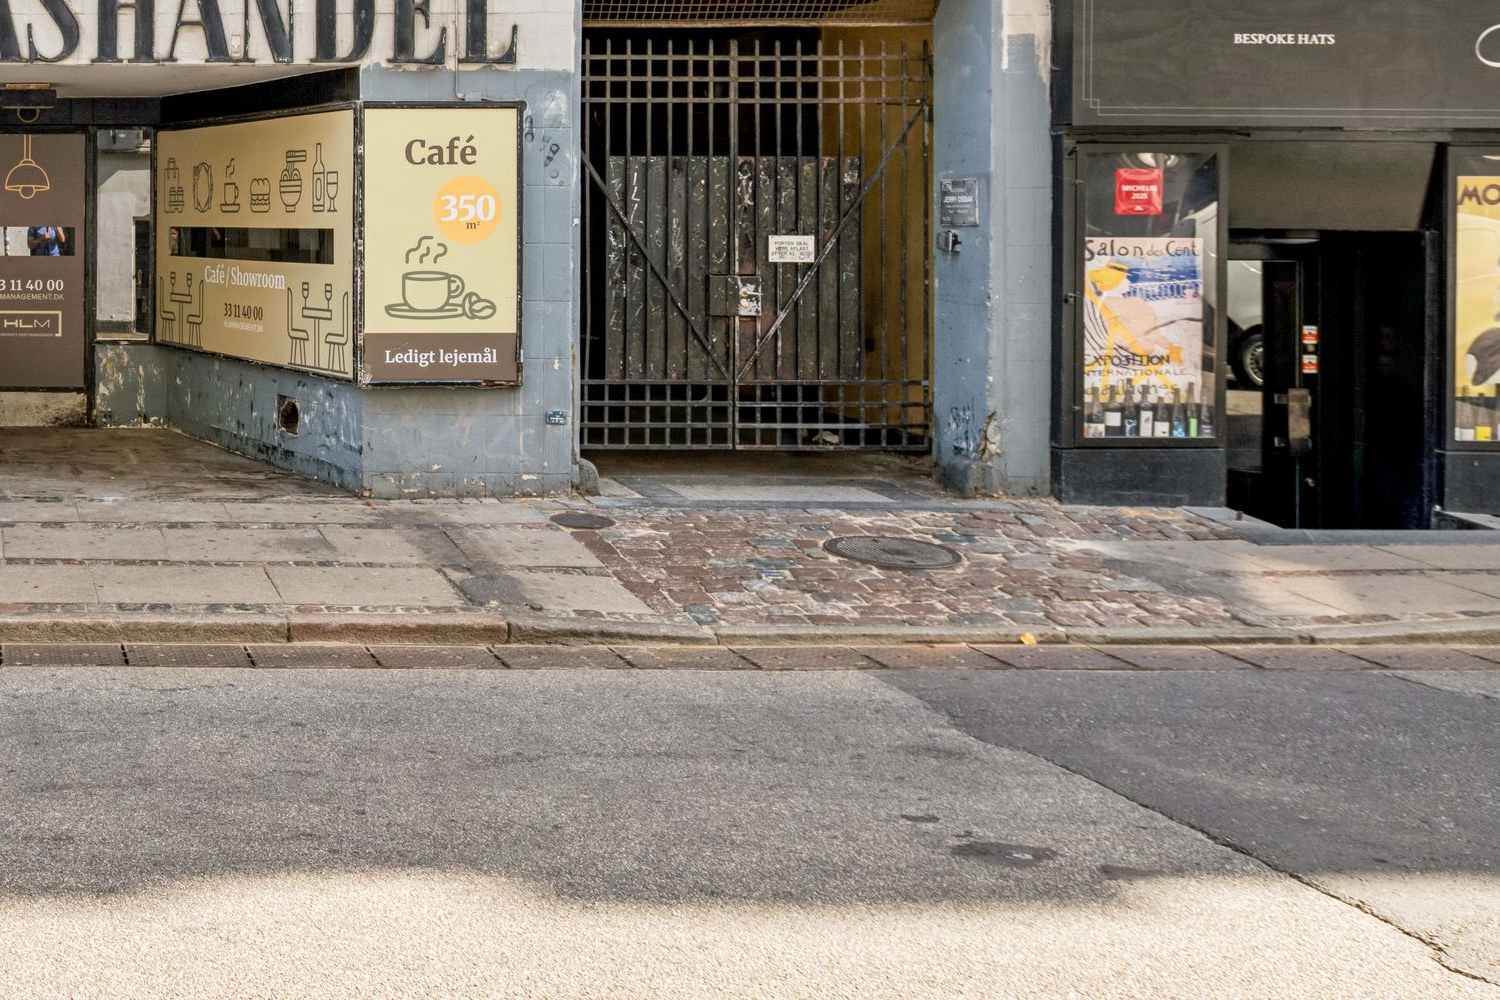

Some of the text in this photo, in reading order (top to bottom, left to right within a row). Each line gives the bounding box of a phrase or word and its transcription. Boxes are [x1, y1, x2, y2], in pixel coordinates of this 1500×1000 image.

[1233, 32, 1336, 46] BESPOKE HATS
[405, 135, 477, 166] Café
[1121, 184, 1158, 192] MICHELIN
[1457, 183, 1500, 206] MO
[440, 194, 496, 222] 350
[1084, 240, 1143, 261] Salon
[1166, 240, 1199, 257] Cent
[10, 279, 22, 291] 11
[26, 279, 43, 291] 40
[46, 279, 64, 291] 00
[205, 264, 225, 284] Café
[231, 266, 285, 290] Showroom
[224, 302, 263, 321] 33 11 40 00
[4, 319, 50, 328] HLM
[385, 348, 497, 369] Ledigt lejemål
